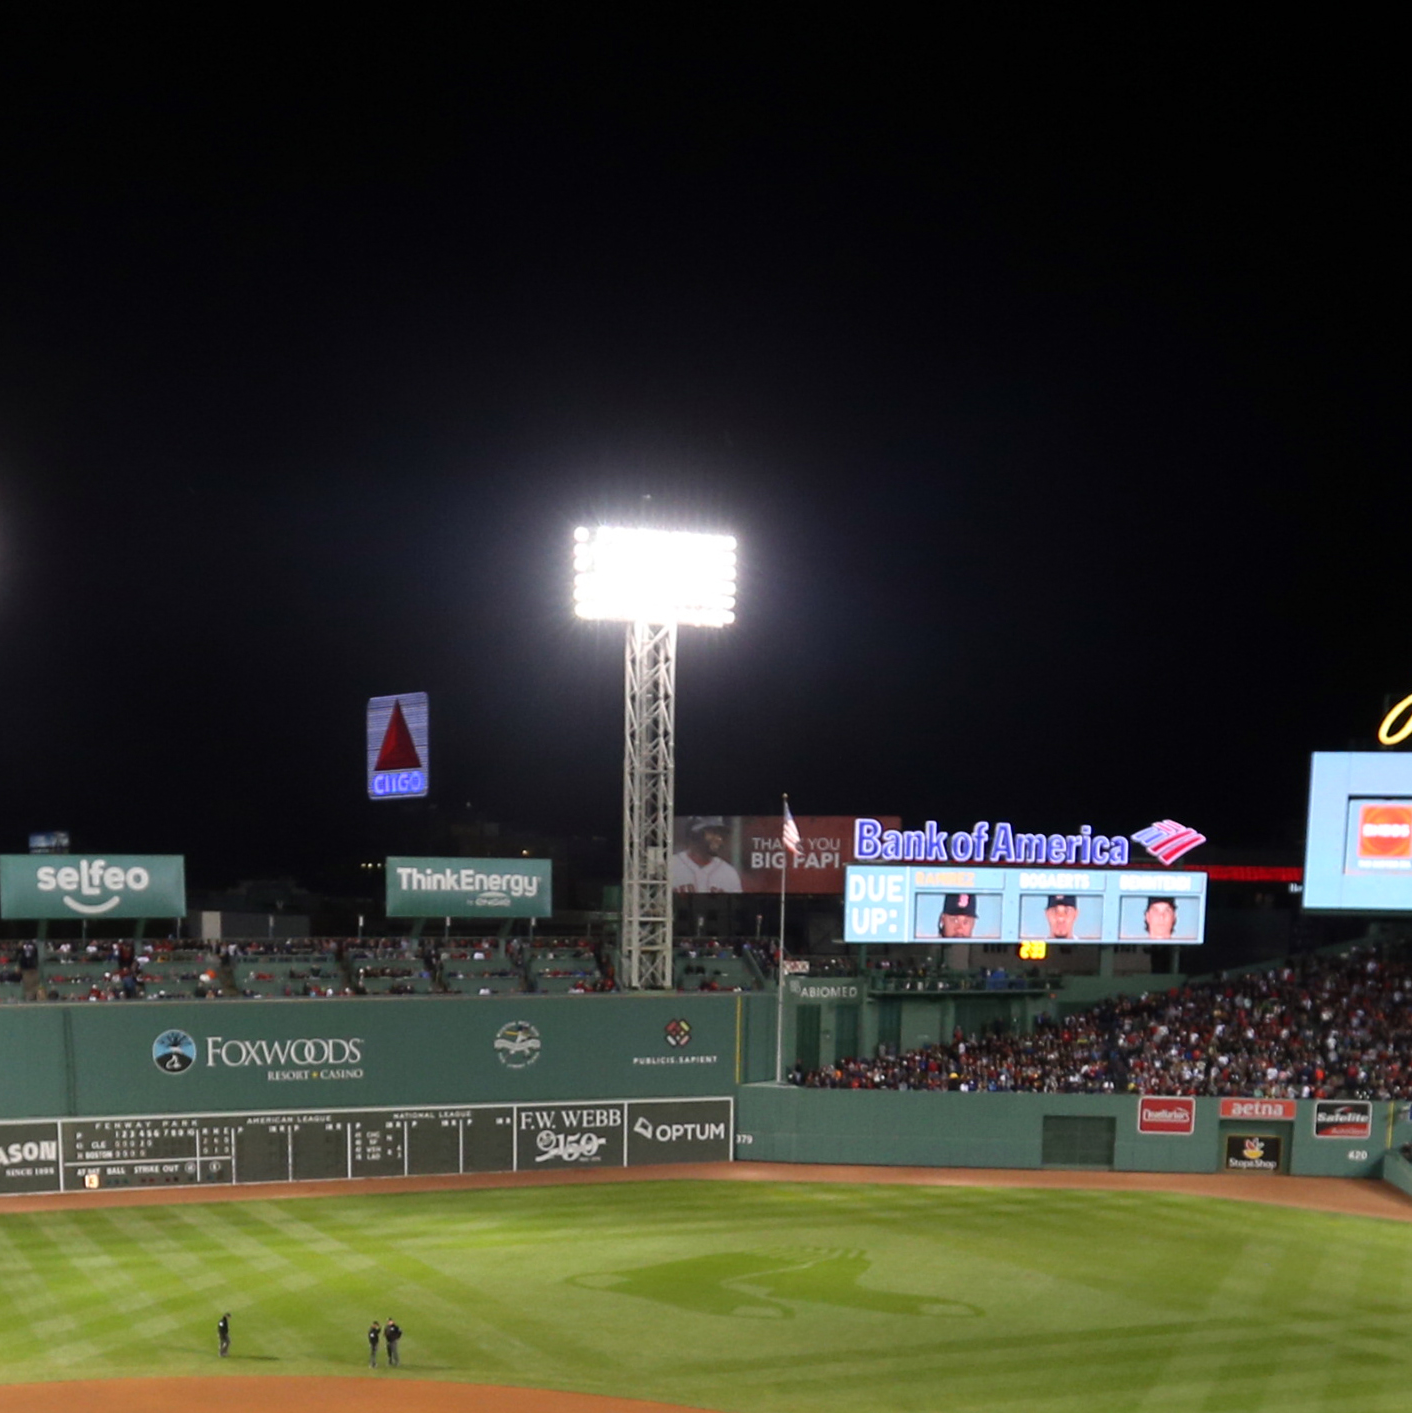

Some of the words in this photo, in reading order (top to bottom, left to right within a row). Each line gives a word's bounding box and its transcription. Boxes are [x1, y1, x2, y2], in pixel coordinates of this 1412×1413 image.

[372, 771, 423, 795] CITGO
[752, 838, 803, 849] THA
[808, 838, 840, 849] YOU
[854, 818, 948, 861] Bank
[951, 820, 989, 861] of
[991, 821, 1129, 865] America
[751, 853, 786, 868] BIG
[396, 867, 539, 897] ThinkEnergy
[915, 871, 975, 887] RAMIREZ
[1019, 873, 1090, 889] BOGAERTS
[849, 874, 904, 902] DUE
[852, 908, 898, 934] UP:
[800, 986, 858, 998] ABIOMED
[206, 1036, 361, 1067] FOXWOODS
[267, 1070, 309, 1081] RESORT
[320, 1068, 363, 1080] CASINO
[393, 1111, 435, 1119] NATIONAL
[439, 1110, 471, 1118] LEAGUE
[1231, 1101, 1284, 1116] aetna
[95, 1121, 151, 1129] FENWAY
[162, 1119, 197, 1127] PARK
[246, 1116, 293, 1125] AMERICAN
[297, 1115, 331, 1123] LEAGUE
[520, 1111, 556, 1130] F.W.
[562, 1108, 621, 1128] WEBB
[1317, 1112, 1370, 1122] Safelite
[655, 1123, 725, 1142] OPTUM
[1348, 1151, 1368, 1161] 420
[6, 1168, 32, 1176] SINCE
[106, 1166, 125, 1175] BALL
[134, 1165, 159, 1174] STRIKE
[162, 1164, 179, 1173] OUT
